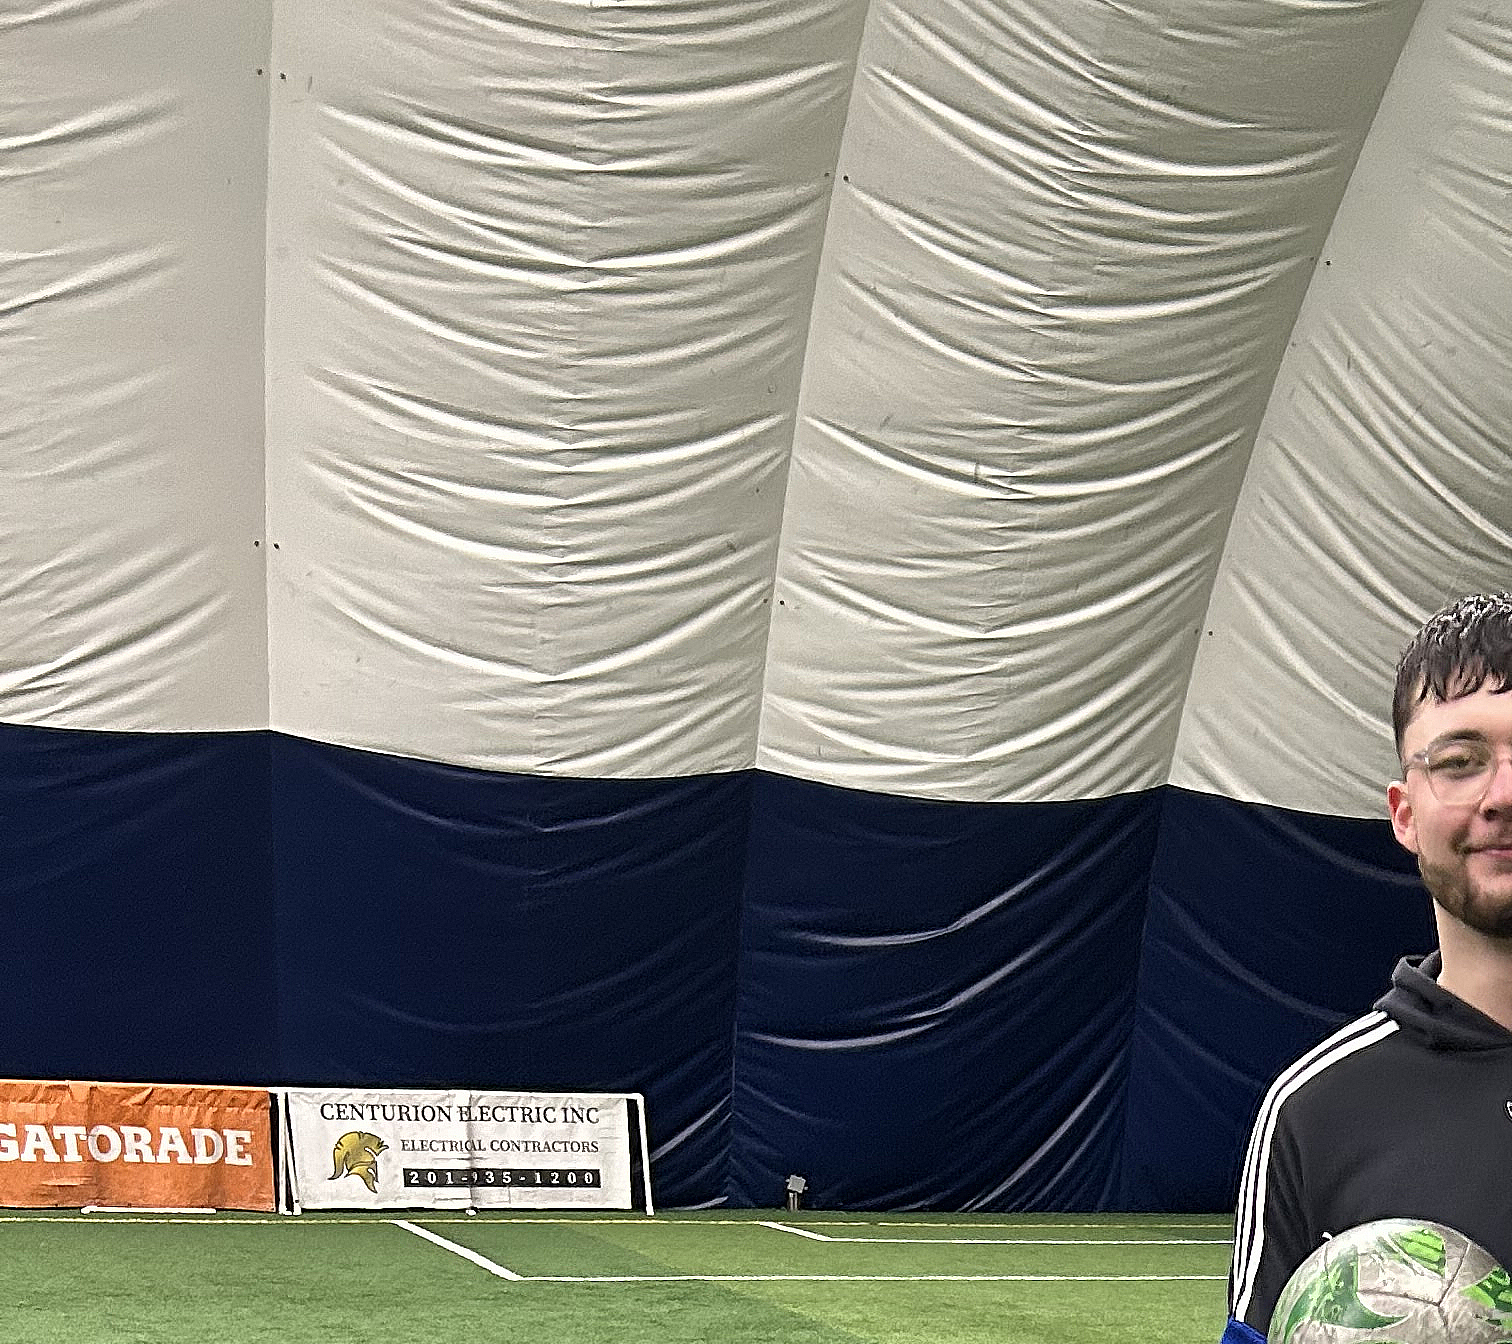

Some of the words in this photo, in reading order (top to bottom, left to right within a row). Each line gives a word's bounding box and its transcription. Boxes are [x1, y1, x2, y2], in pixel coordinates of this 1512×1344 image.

[320, 1103, 453, 1121] CENTURION
[457, 1105, 556, 1124] ELECTRIC
[561, 1106, 600, 1124] INC
[400, 1139, 487, 1152] ELECTRICAL
[490, 1139, 599, 1153] CONTRACTORS
